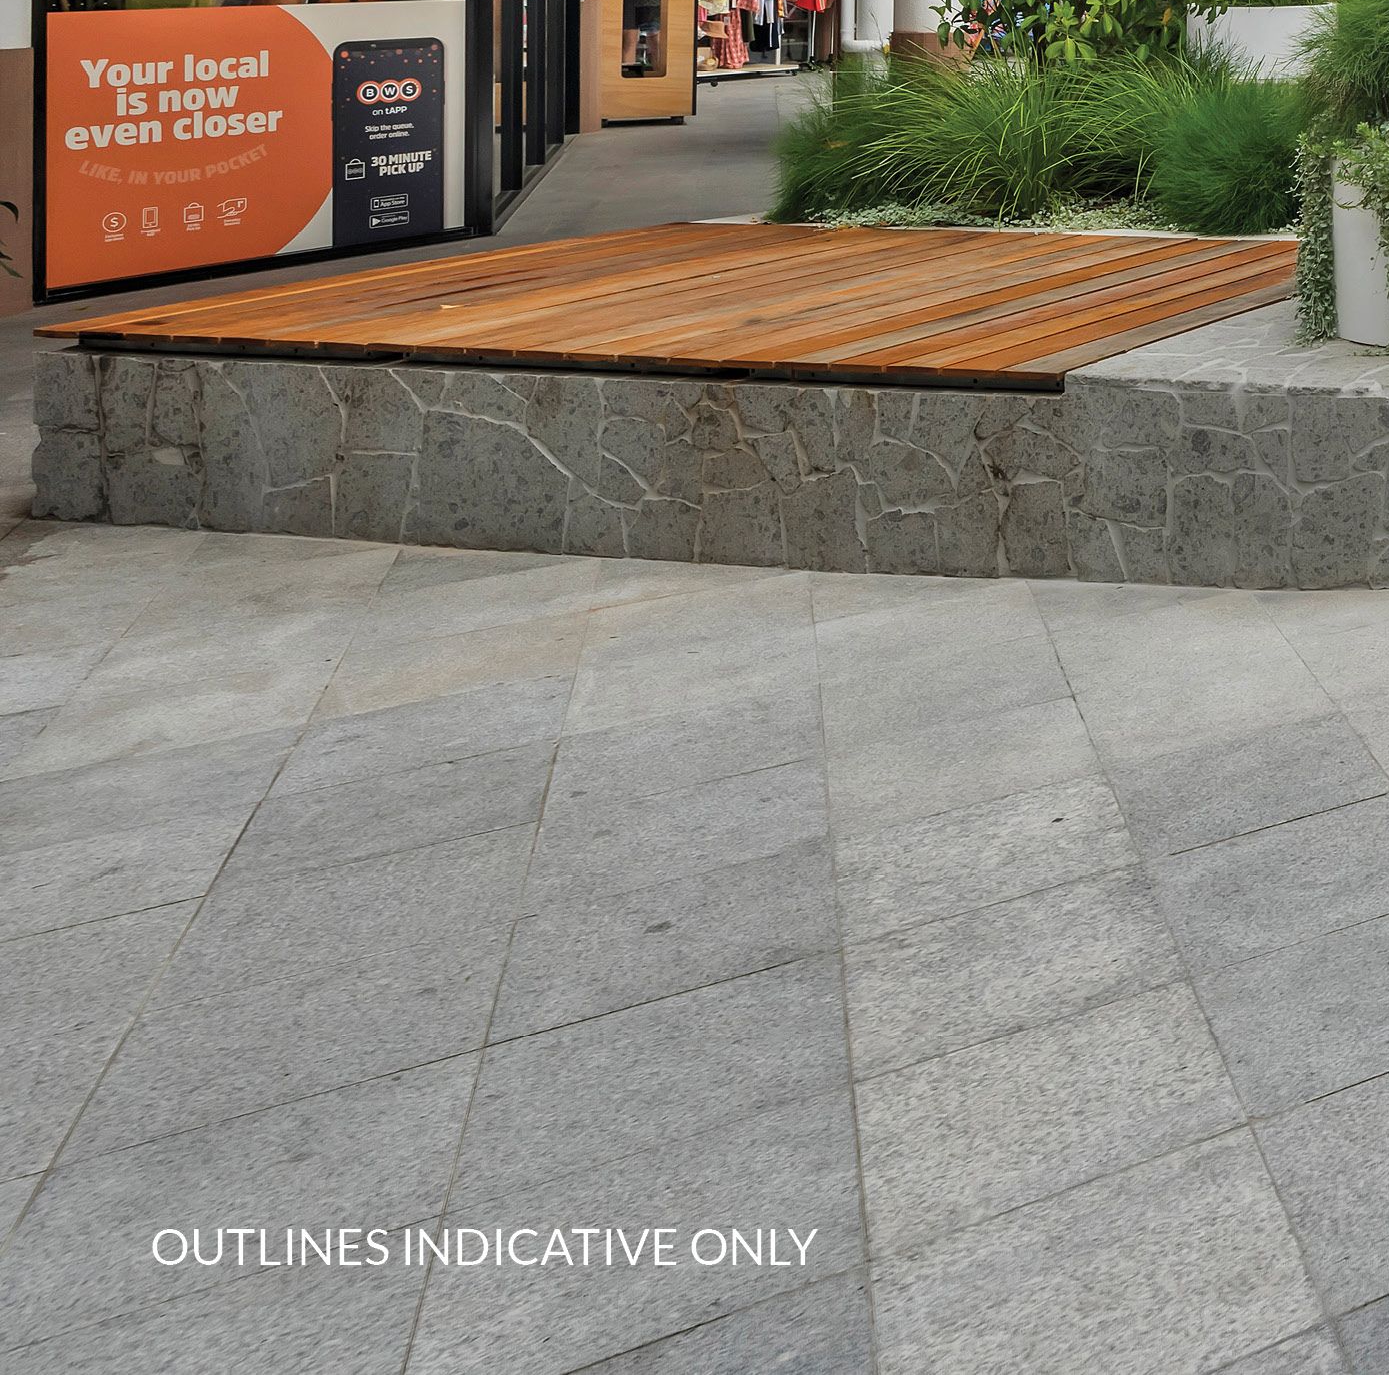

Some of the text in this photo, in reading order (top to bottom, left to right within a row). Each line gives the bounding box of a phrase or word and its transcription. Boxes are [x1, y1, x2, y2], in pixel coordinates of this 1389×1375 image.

[80, 50, 269, 89] Your local
[116, 85, 240, 117] is now
[372, 108, 384, 116] on
[64, 109, 284, 151] even closer
[364, 124, 380, 133] Skip
[369, 132, 388, 140] order
[78, 143, 269, 186] LIKE, IN YOUR POCKET
[371, 150, 432, 167] 30 MINUTE
[379, 162, 425, 177] PICK UP
